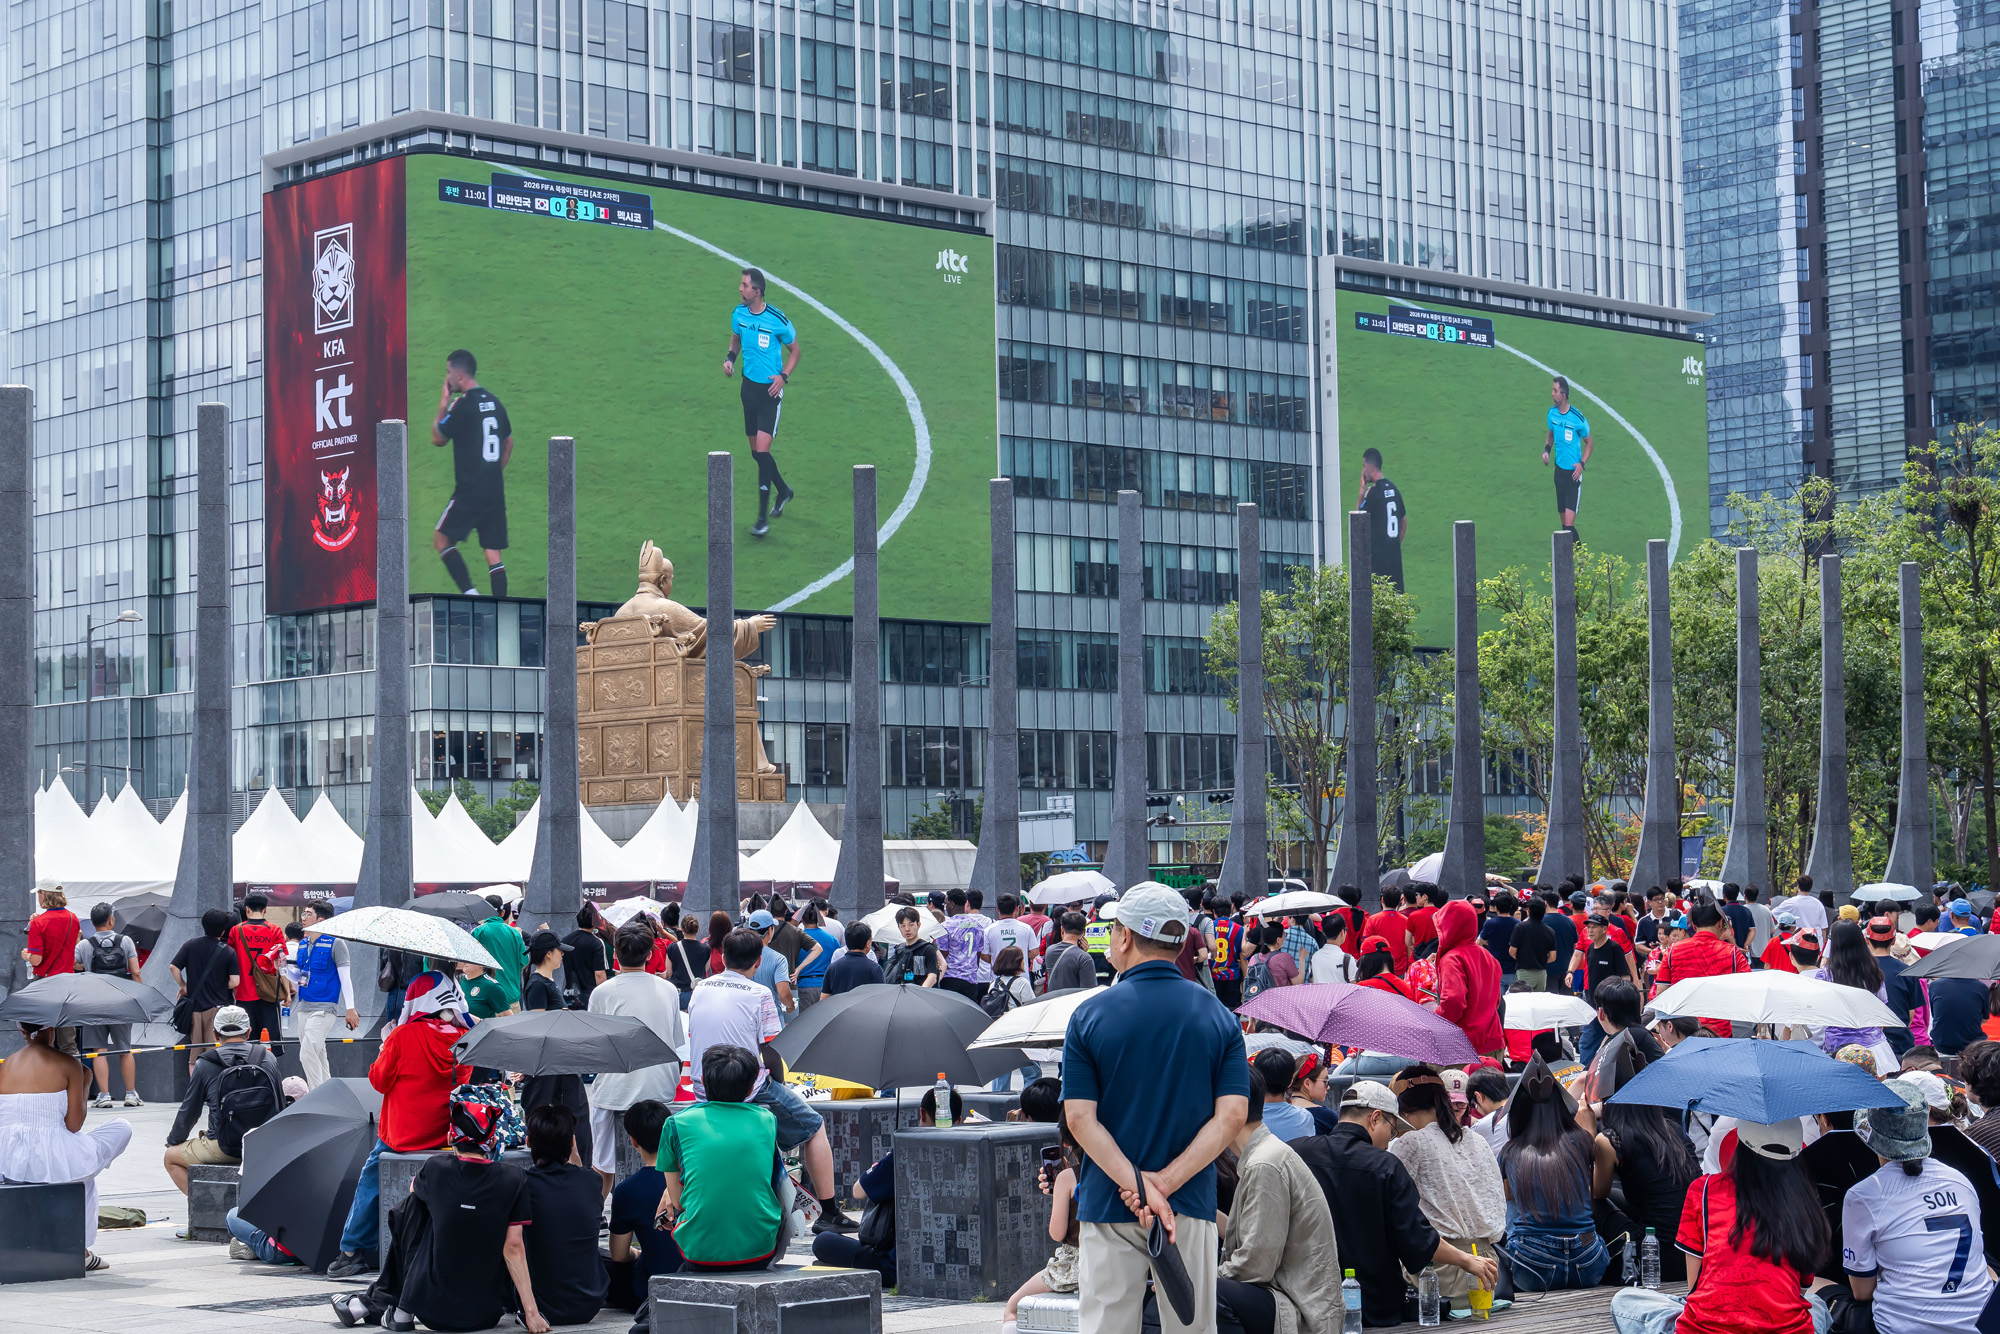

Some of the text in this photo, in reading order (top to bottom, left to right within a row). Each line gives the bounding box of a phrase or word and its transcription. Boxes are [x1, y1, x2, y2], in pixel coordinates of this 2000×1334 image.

[445, 185, 486, 200] 후반 11:01
[524, 181, 540, 189] 2026
[555, 185, 571, 195] 북중미
[573, 187, 588, 197] 월드컵
[496, 193, 531, 208] 대한민국
[555, 202, 561, 212] 0
[583, 206, 589, 216] 1
[617, 210, 642, 223] 멕시코
[944, 274, 961, 284] LIVE
[1372, 319, 1386, 328] 11:01
[1393, 321, 1415, 333] 대한민국
[1430, 326, 1435, 336] 0
[1448, 329, 1453, 339] 1
[1470, 332, 1487, 343] 멕시코
[324, 339, 345, 358] KFA
[1687, 377, 1699, 385] LIVE
[316, 374, 353, 432] kt
[312, 434, 357, 450] OFFICIAL PARTNER
[482, 416, 500, 462] 6
[1386, 501, 1399, 538] 6
[303, 890, 336, 899] 종합안내소
[582, 887, 607, 896] 축구협회
[1214, 937, 1228, 963] 8
[249, 947, 264, 976] 7
[1453, 1079, 1461, 1089] B
[1923, 1191, 1958, 1210] SON
[1924, 1213, 1972, 1294] 7
